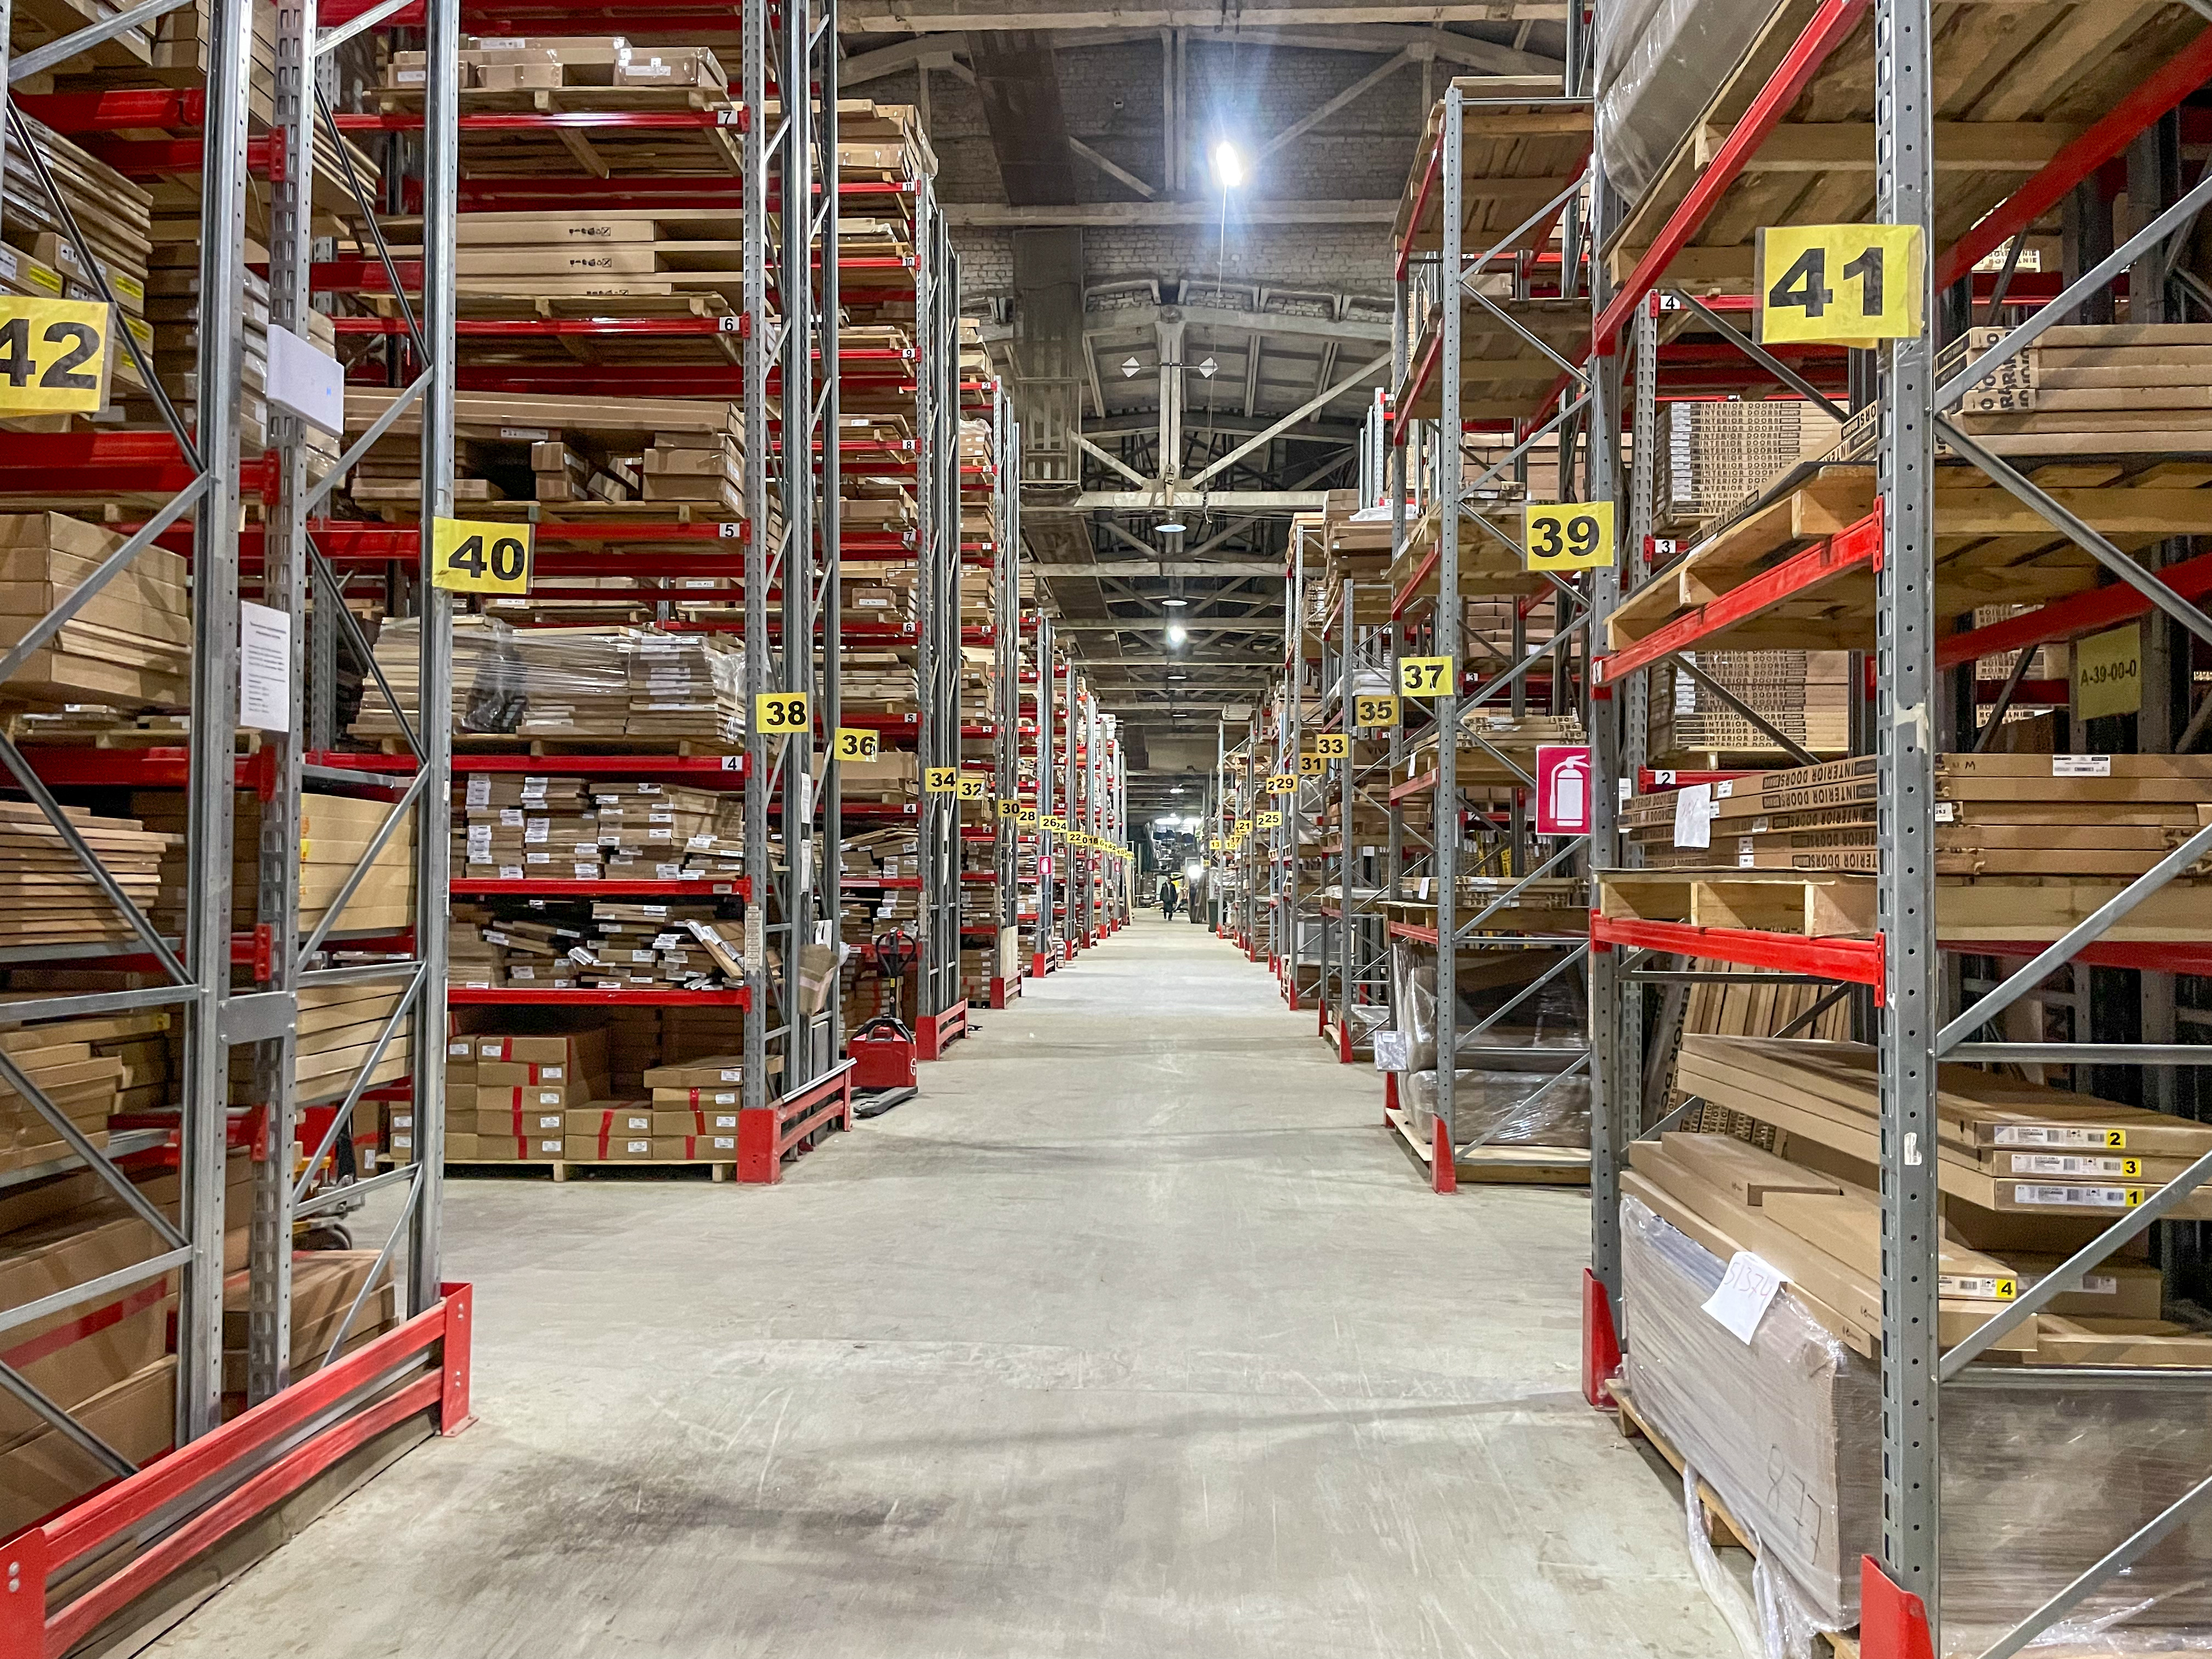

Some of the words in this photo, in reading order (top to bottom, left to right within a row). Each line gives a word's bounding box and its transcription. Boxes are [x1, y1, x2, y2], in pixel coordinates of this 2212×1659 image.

[723, 112, 732, 124] 7
[905, 182, 912, 191] 11
[905, 257, 913, 266] 10
[1770, 247, 1883, 318] 41
[1666, 297, 1675, 309] 4
[724, 318, 734, 331] 6
[0, 319, 100, 389] 42
[906, 349, 912, 358] 9
[906, 441, 912, 450] 8
[725, 524, 734, 537] 5
[907, 532, 913, 541] 7
[1532, 516, 1599, 557] 39
[1662, 541, 1671, 553] 3
[448, 534, 527, 582] 40
[906, 622, 912, 632] 6
[1404, 664, 1444, 689] 37
[2081, 659, 2136, 686] A-39-00-0
[766, 701, 807, 726] 38
[1360, 701, 1392, 721] 35
[907, 713, 914, 723] 5
[842, 735, 873, 755] 36
[1318, 739, 1344, 753] 33
[727, 758, 737, 770] 4
[1301, 758, 1321, 770] 31
[1965, 761, 1975, 770] M
[931, 772, 956, 788] 34
[1662, 772, 1670, 784] 2
[1780, 769, 1808, 787] DOORS
[1812, 763, 1854, 782] INTERIOR
[1276, 778, 1294, 788] 29
[962, 783, 982, 797] 32
[1781, 791, 1809, 807] DOORS
[1813, 785, 1855, 804] INTERIOR
[1002, 803, 1020, 814] 30
[1019, 811, 1036, 821] 28
[1265, 815, 1279, 823] 25
[1811, 854, 1839, 868] DOORS
[2110, 1133, 2120, 1145] 2
[2126, 1161, 2136, 1173] 3
[2130, 1191, 2137, 1204] 1
[2001, 1282, 2012, 1295] 4
